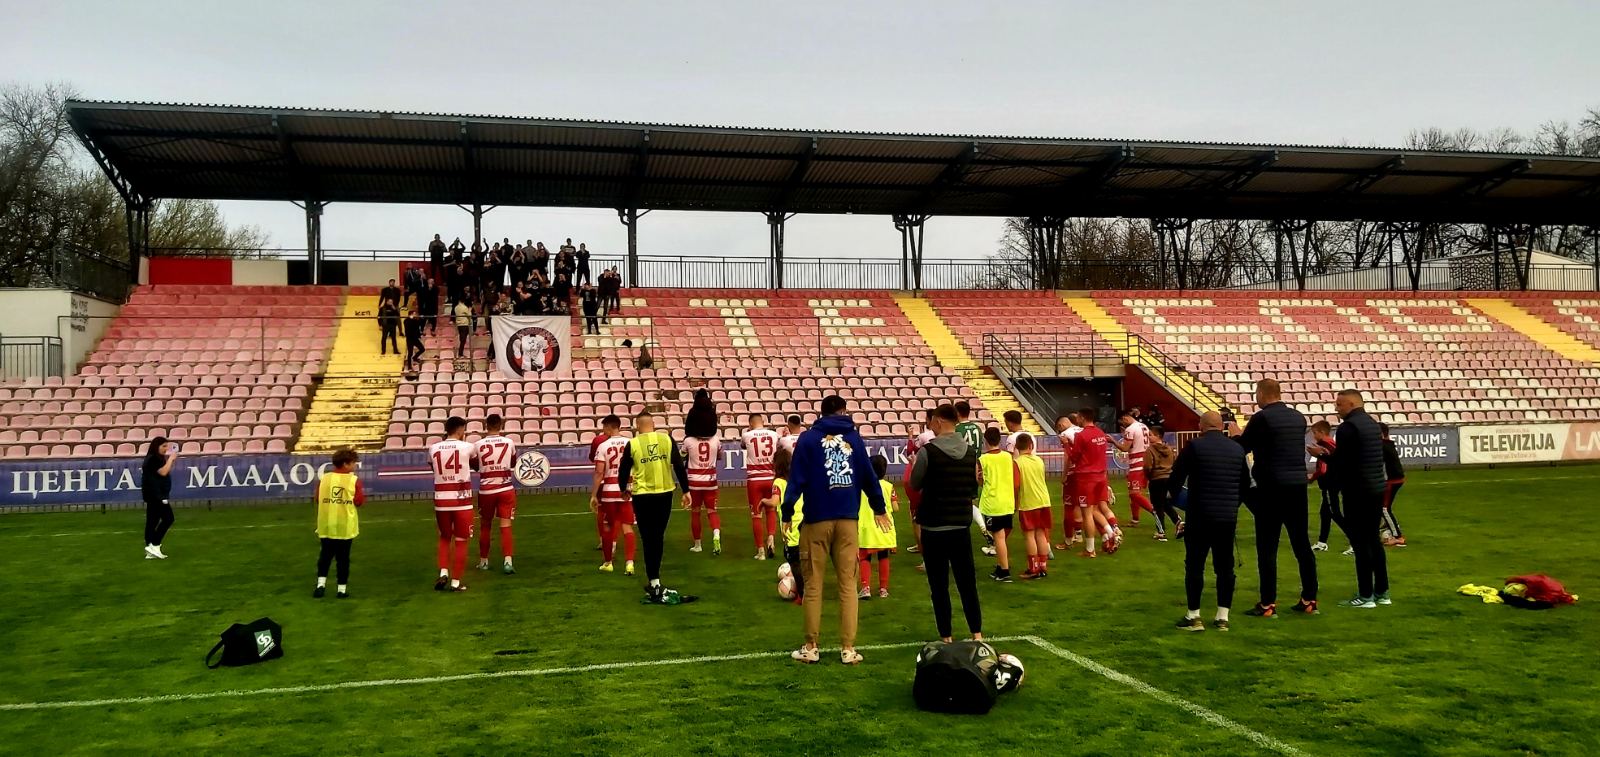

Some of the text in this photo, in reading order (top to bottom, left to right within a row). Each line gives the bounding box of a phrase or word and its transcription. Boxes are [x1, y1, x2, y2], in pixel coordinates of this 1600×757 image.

[749, 436, 774, 458] 13
[963, 428, 980, 448] 41
[1389, 433, 1440, 446] ENIJUM
[1470, 433, 1556, 453] TELEVIZIJA
[1575, 431, 1600, 452] LA
[480, 442, 509, 467] 27
[698, 442, 711, 462] 9
[824, 447, 849, 462] Take
[1395, 446, 1448, 459] URANJE
[432, 449, 463, 476] 14
[832, 460, 841, 473] it
[10, 461, 362, 499] ЦЕНТА МЛАДОС
[829, 472, 853, 485] chill
